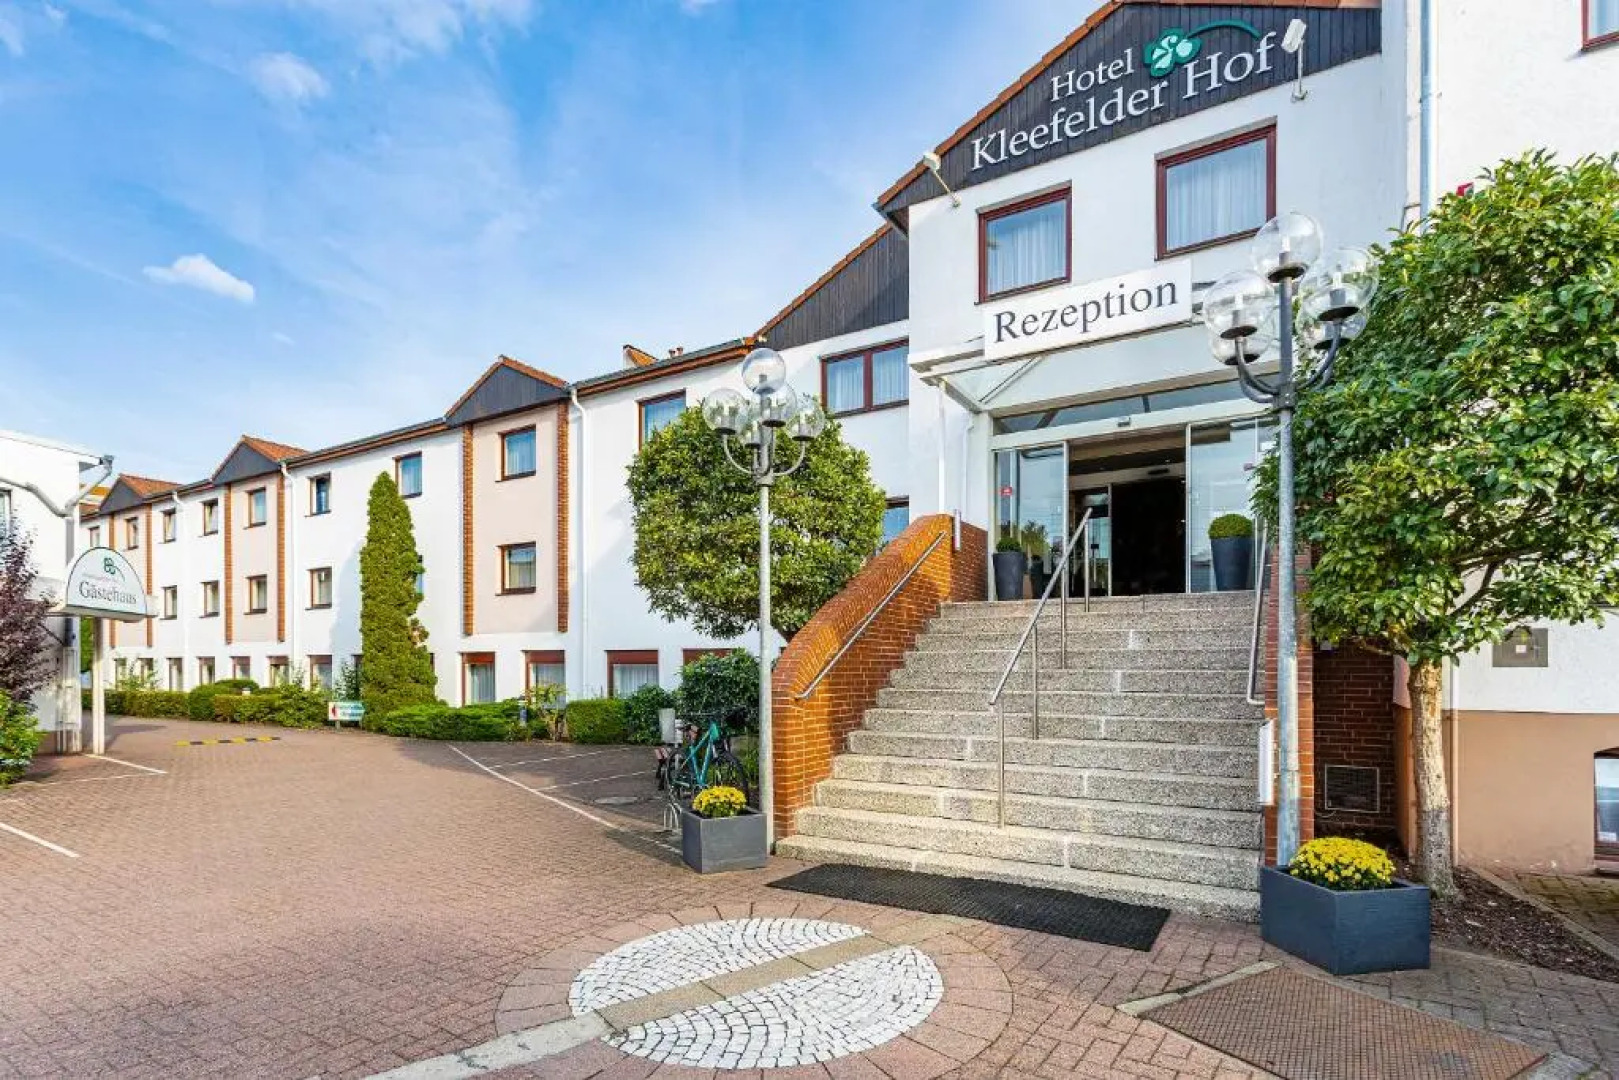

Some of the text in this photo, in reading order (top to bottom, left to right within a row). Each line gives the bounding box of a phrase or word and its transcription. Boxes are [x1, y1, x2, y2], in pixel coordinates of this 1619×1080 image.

[971, 31, 1277, 171] Kleefelder Hof
[1050, 48, 1135, 102] Hotel
[993, 282, 1178, 344] Rezeption
[79, 581, 137, 604] Gästehaus
